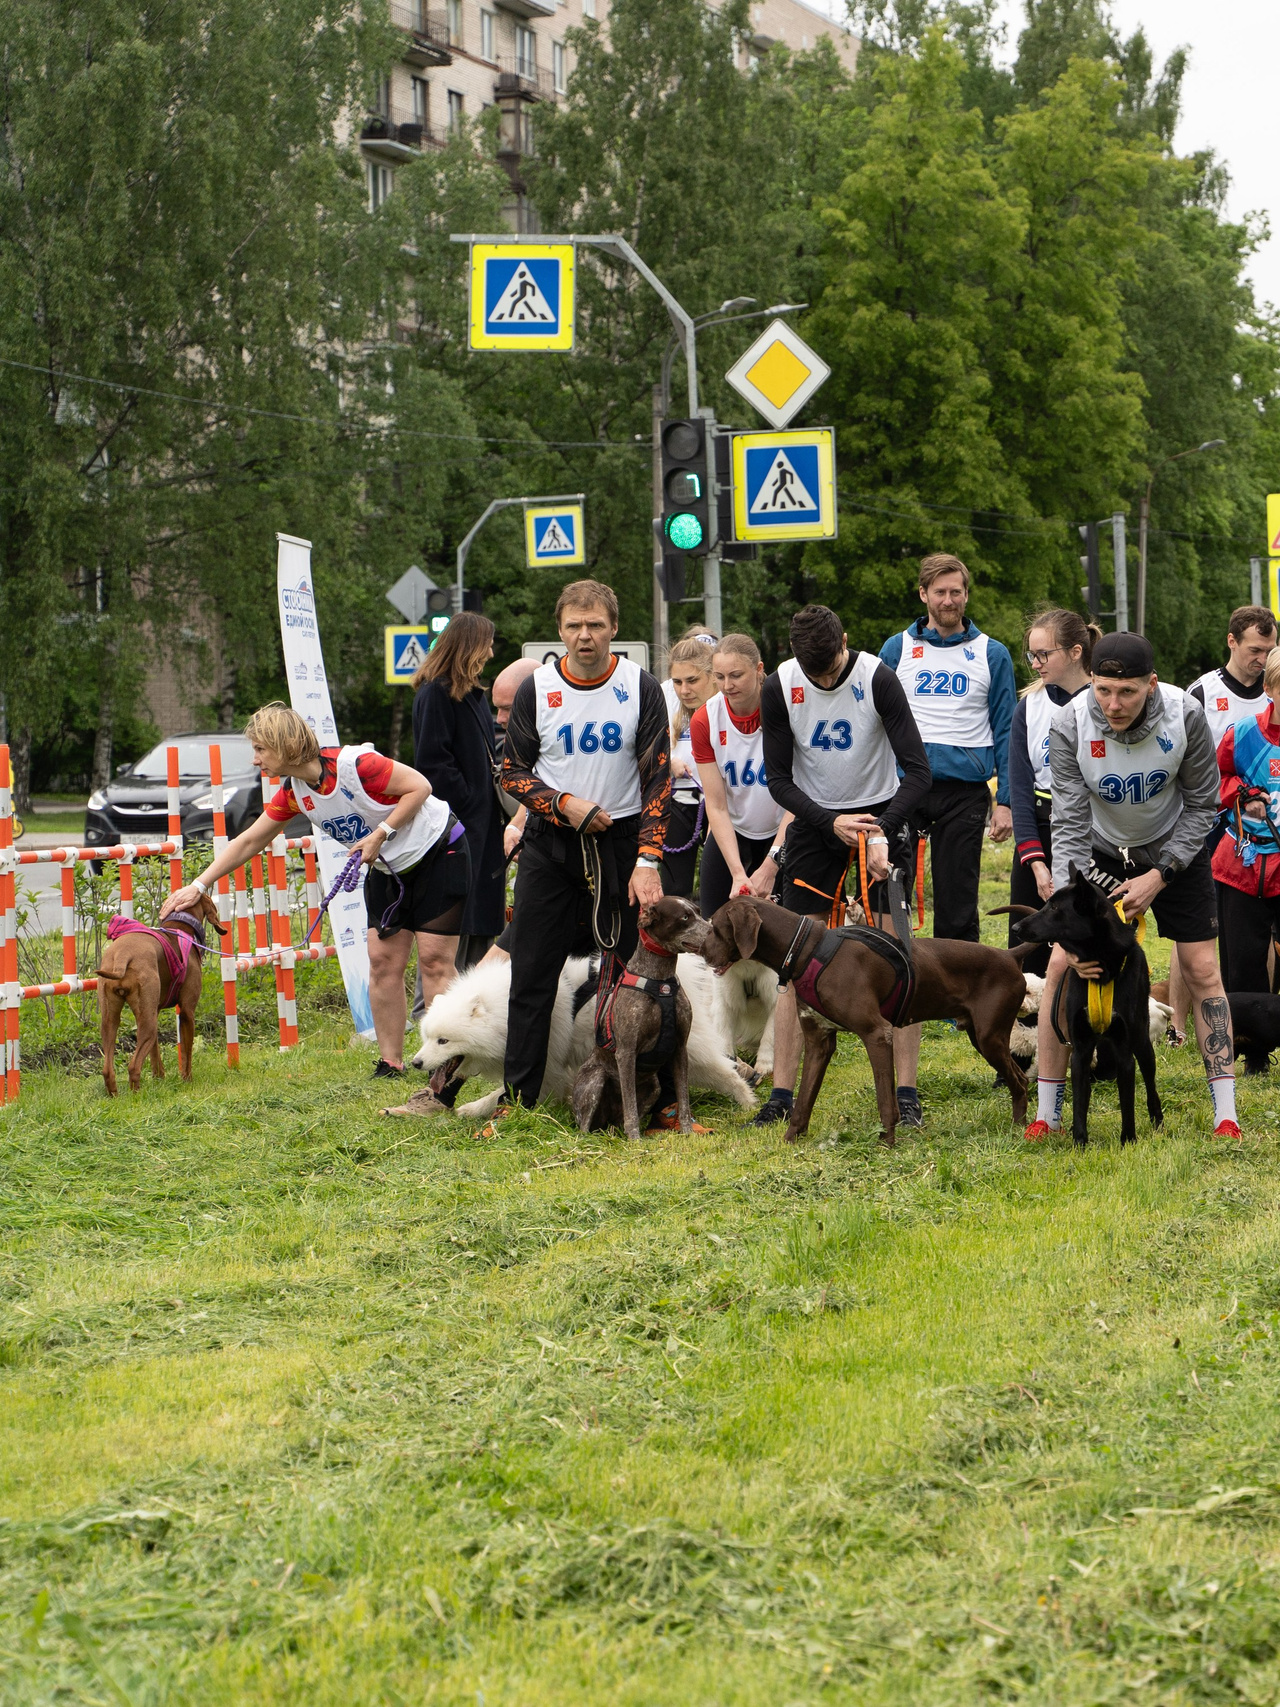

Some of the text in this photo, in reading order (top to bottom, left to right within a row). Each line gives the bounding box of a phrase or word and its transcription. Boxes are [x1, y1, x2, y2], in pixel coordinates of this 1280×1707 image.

[686, 473, 700, 497] 7
[914, 670, 969, 697] 220
[557, 720, 623, 756] 168
[810, 718, 852, 751] 43
[724, 759, 769, 787] 166
[1099, 769, 1169, 805] 312
[321, 812, 373, 843] 252
